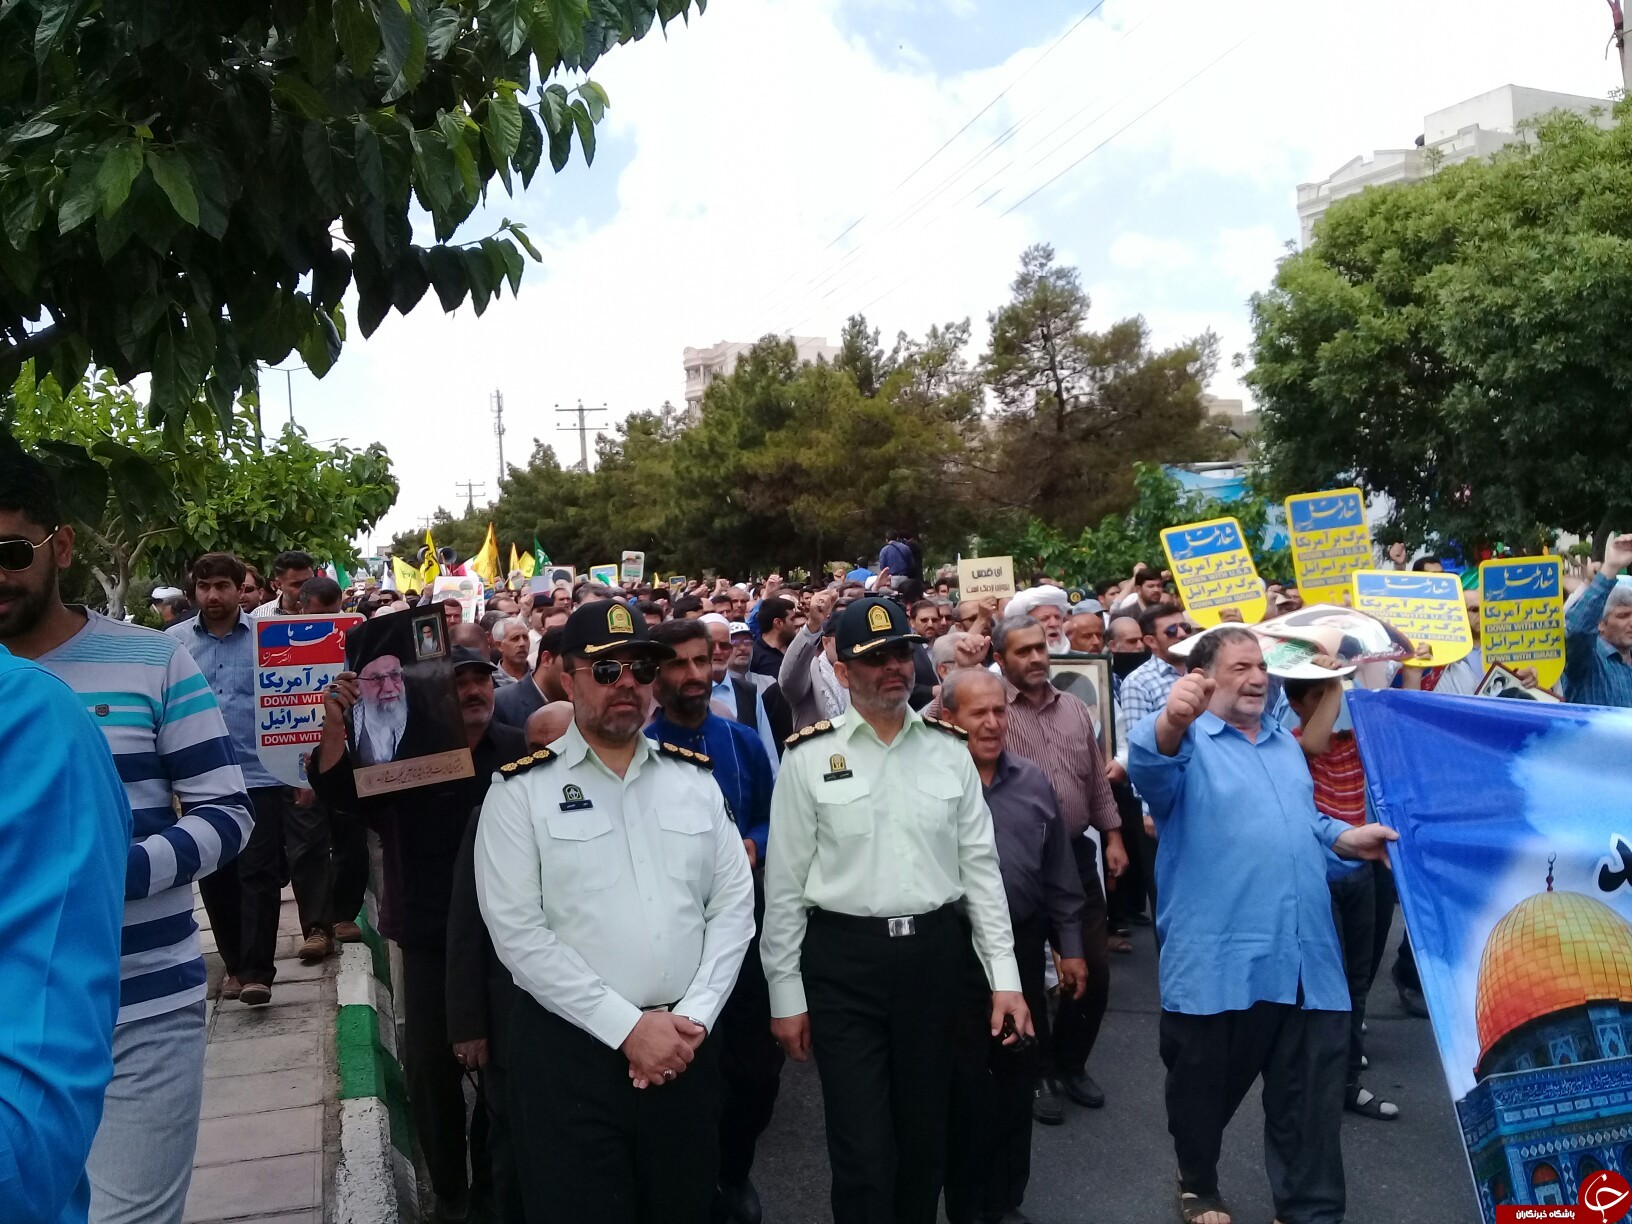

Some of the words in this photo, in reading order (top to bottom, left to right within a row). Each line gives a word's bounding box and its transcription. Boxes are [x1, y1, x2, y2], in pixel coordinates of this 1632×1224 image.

[1295, 530, 1329, 550] آمریکا
[1332, 536, 1341, 548] بر
[1343, 530, 1366, 545] مرگ
[1176, 556, 1211, 575] آمریکا
[1215, 560, 1223, 571] بر
[1225, 554, 1248, 567] مرگ
[1301, 560, 1335, 577] اسرائیل
[1225, 583, 1233, 594] بر
[1235, 577, 1257, 589] مرگ
[1186, 582, 1222, 600] اسرائیل
[1360, 597, 1407, 610] آمریکا
[1413, 605, 1425, 613] بر
[1429, 603, 1461, 614] مرگ
[1485, 602, 1520, 621] آمریکا
[1524, 606, 1533, 619] بر
[1536, 603, 1559, 618] مرگ
[1434, 622, 1465, 633] مرگ
[1487, 623, 1511, 633] DOWN
[1514, 621, 1534, 631] WITH
[1486, 634, 1524, 651] اسرائیل
[1527, 637, 1535, 648] بر
[1539, 632, 1561, 646] مرگ
[1513, 652, 1532, 662] WITH
[259, 667, 313, 693] آمریکا
[264, 695, 298, 706] DOWN
[302, 693, 324, 704] WIT
[261, 708, 316, 730] اسرائیل
[264, 734, 296, 744] DOWN
